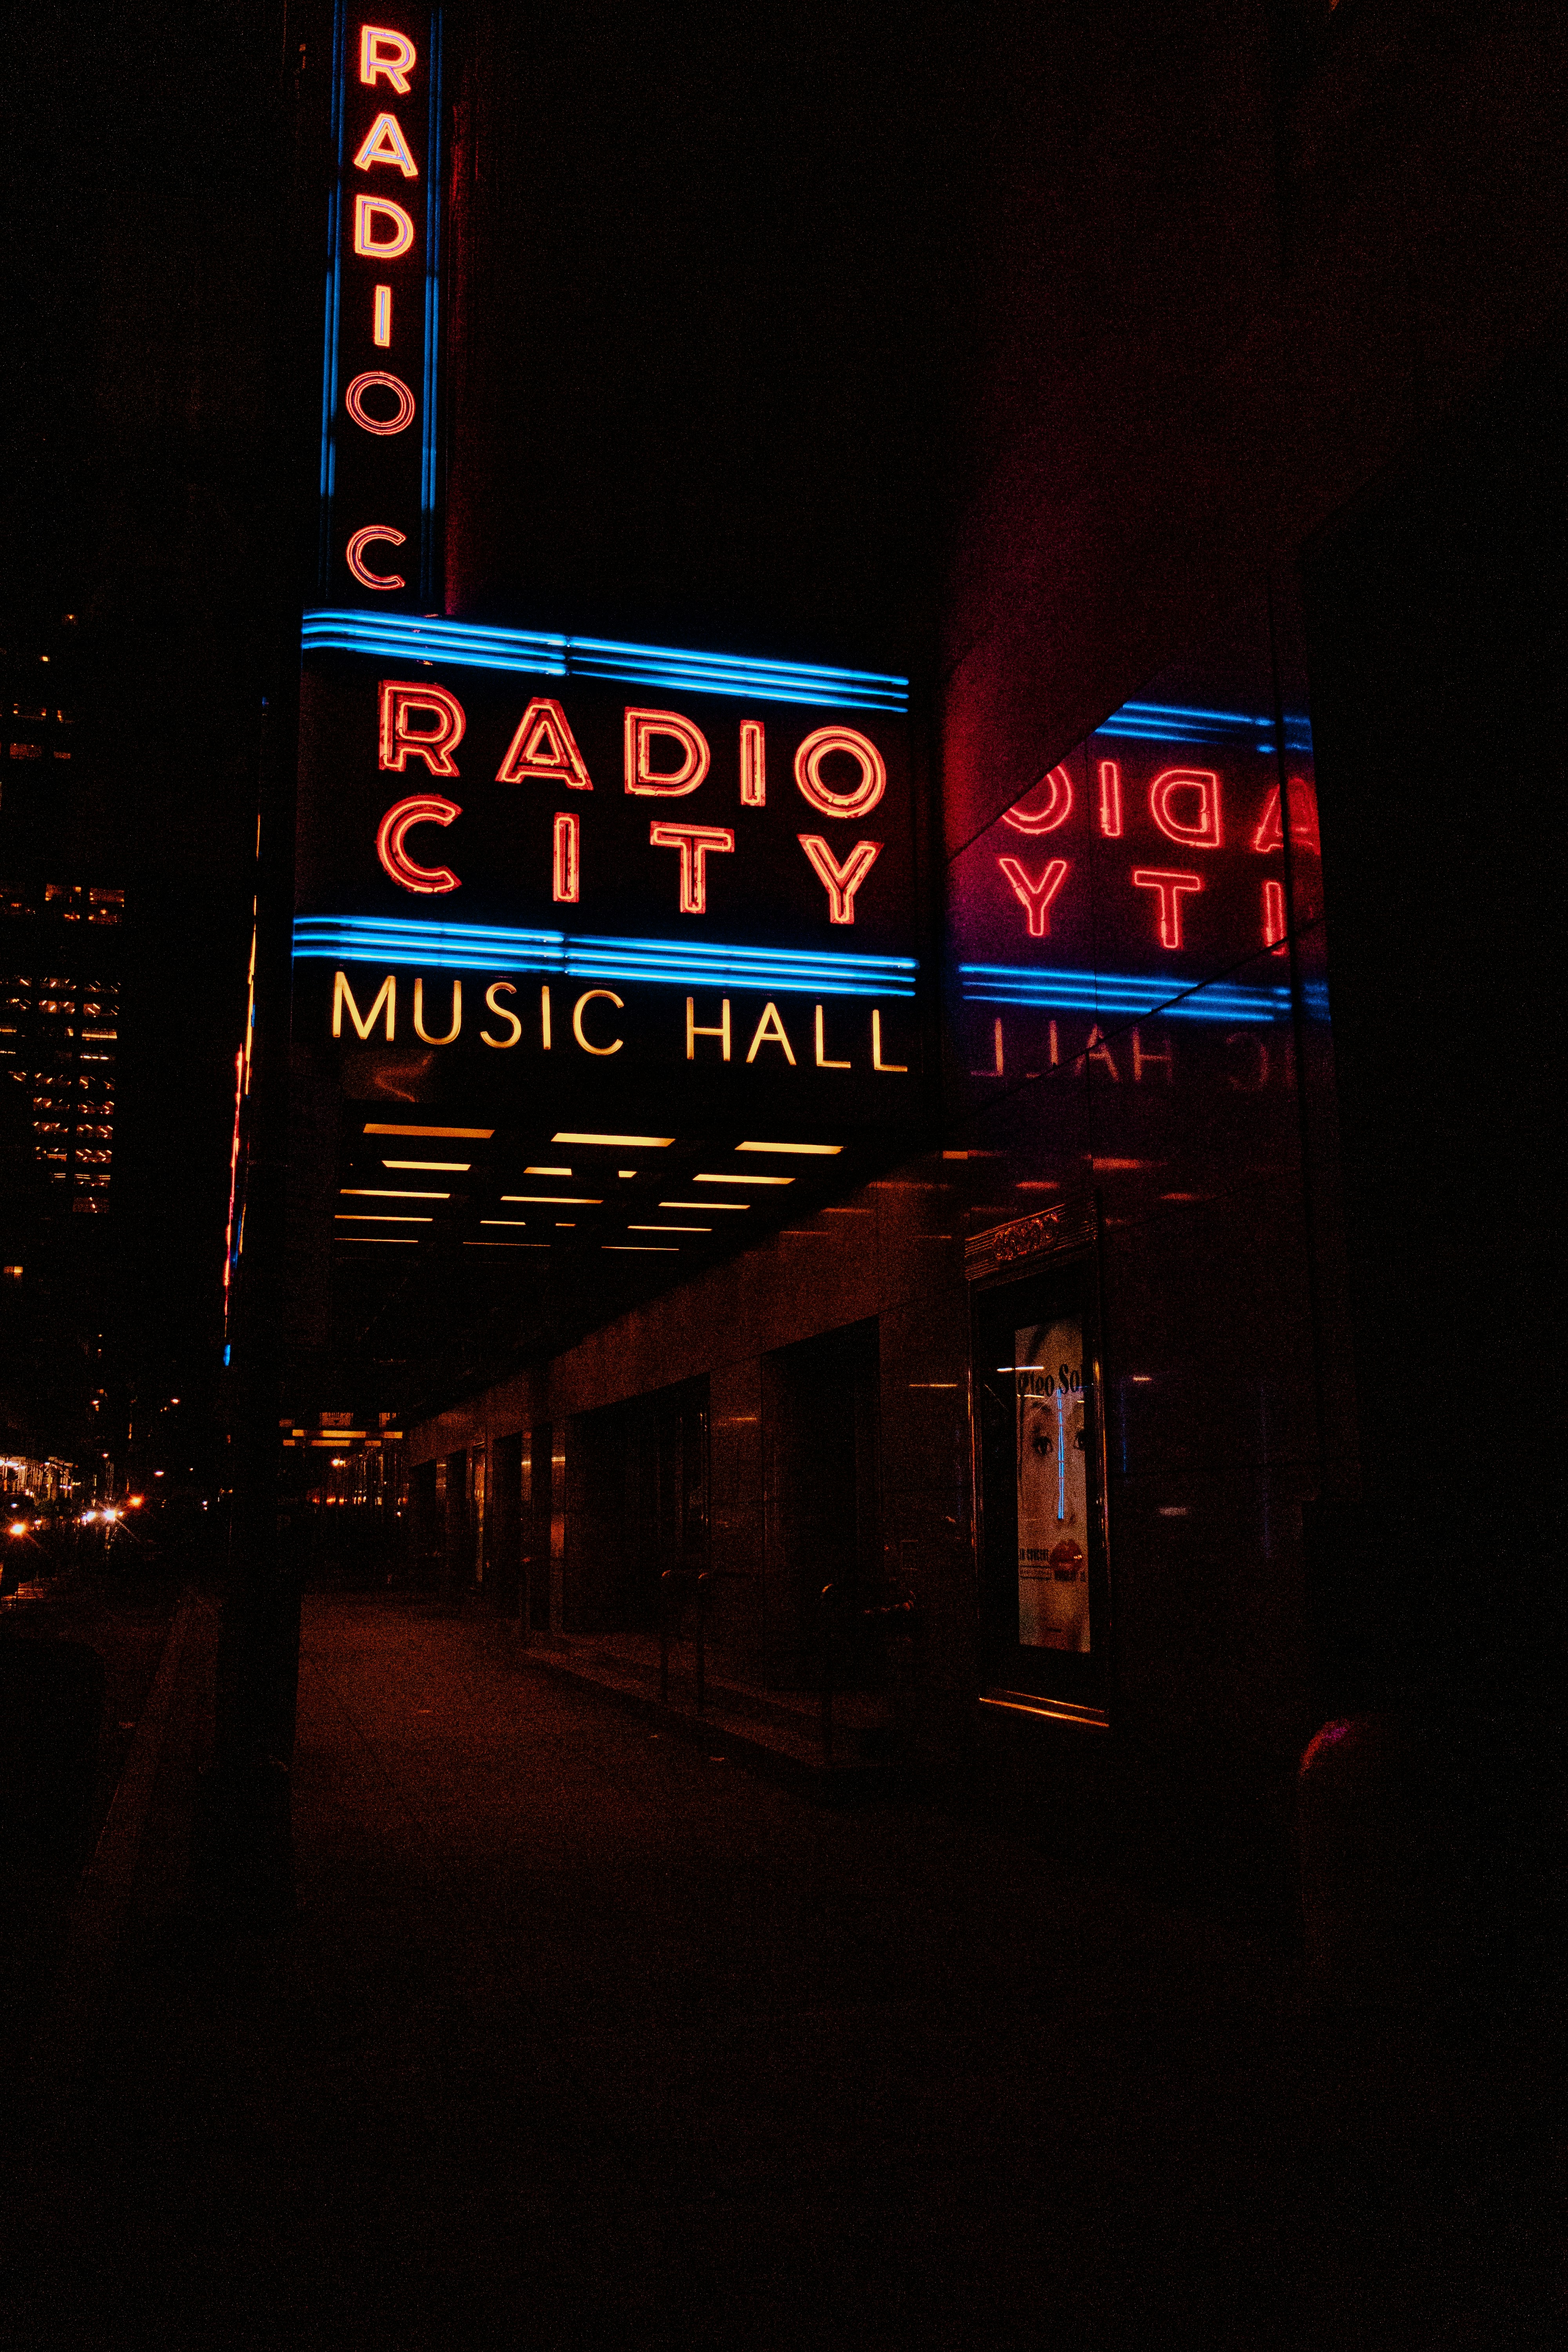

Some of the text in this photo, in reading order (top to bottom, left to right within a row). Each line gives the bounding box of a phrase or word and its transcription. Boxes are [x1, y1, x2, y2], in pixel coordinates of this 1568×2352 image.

[345, 24, 418, 435] RADIO
[377, 679, 887, 819] RADIO
[375, 792, 884, 924] CITY
[332, 971, 908, 1073] MUSIC HALL
